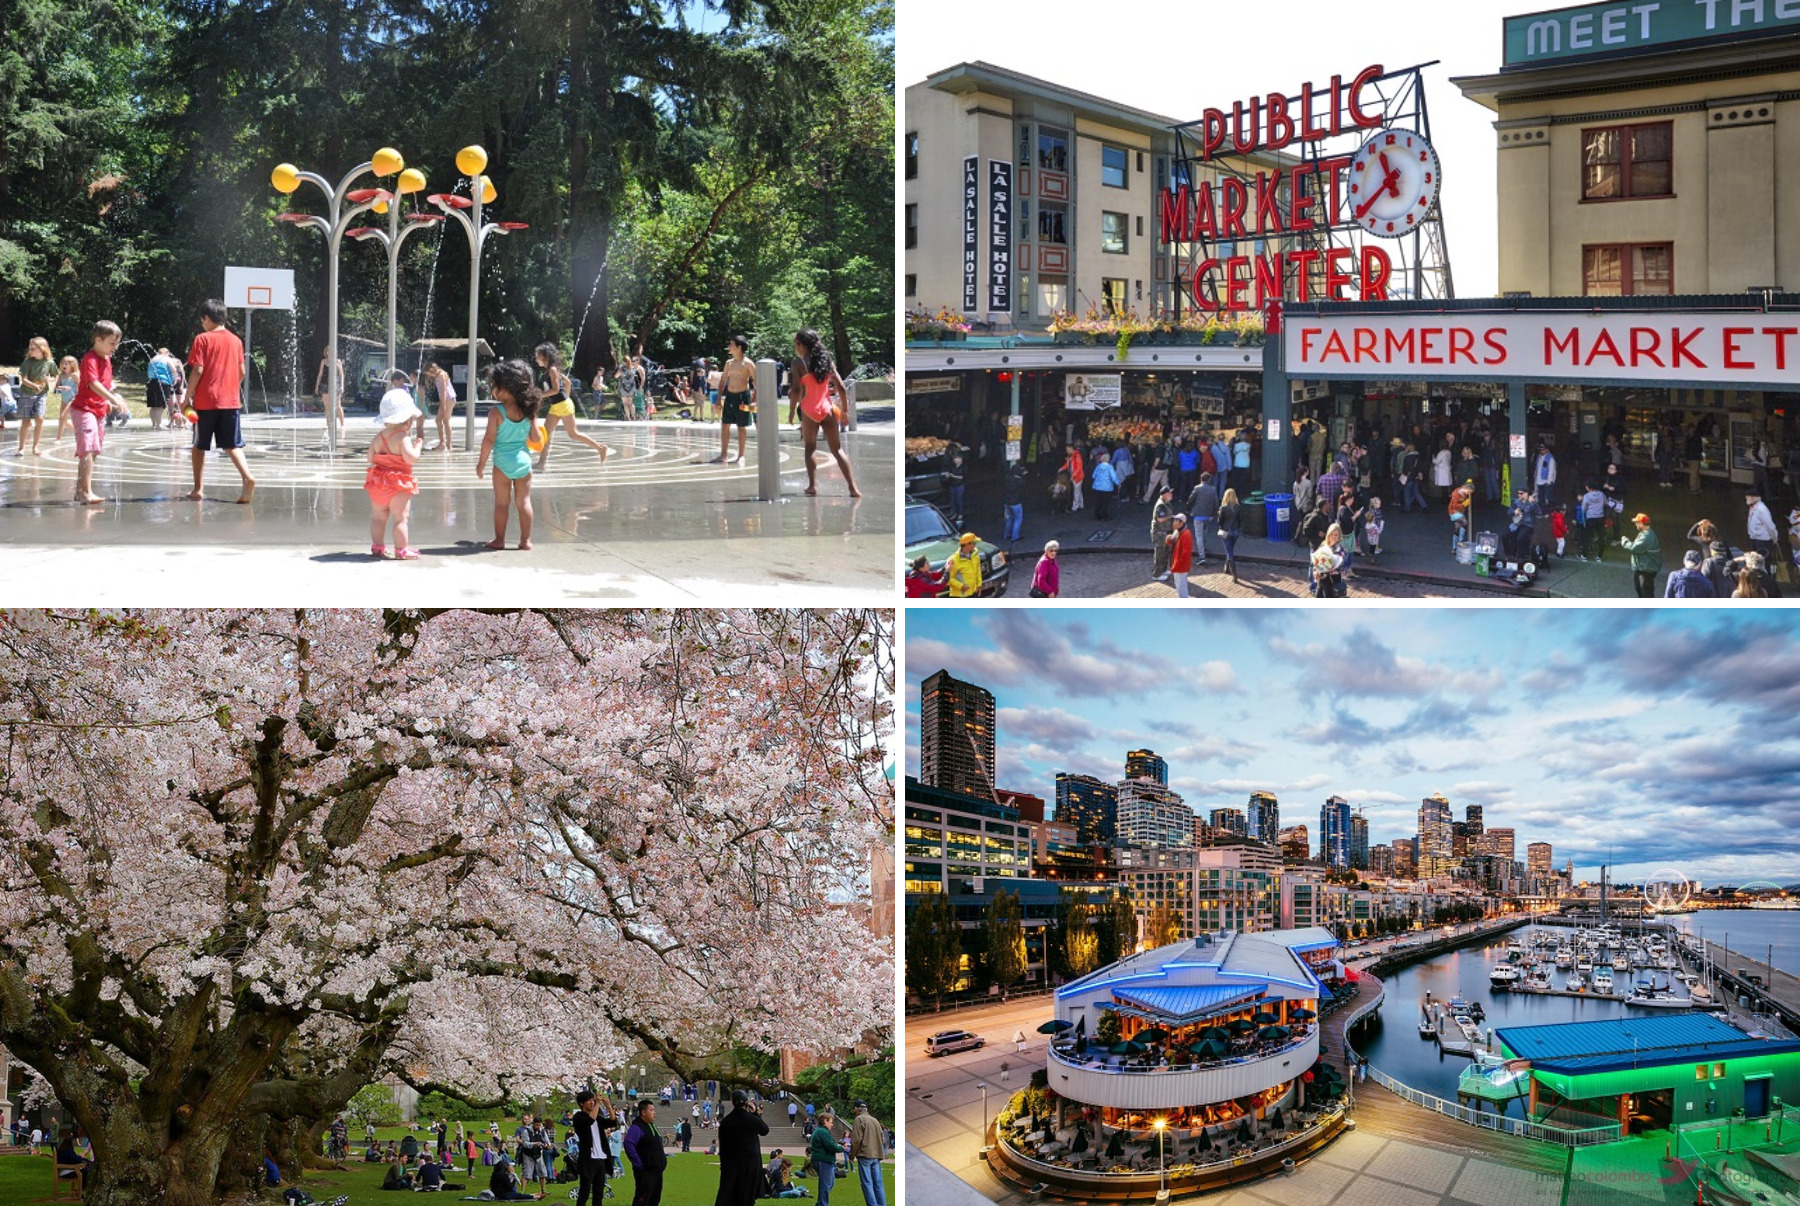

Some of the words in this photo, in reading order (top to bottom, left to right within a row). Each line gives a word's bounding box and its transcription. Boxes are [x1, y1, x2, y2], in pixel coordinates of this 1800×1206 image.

[1527, 3, 1660, 56] MEET
[1202, 64, 1384, 162] PUBLIC
[1386, 134, 1396, 145] 12
[1407, 137, 1412, 148] 1
[1368, 143, 1376, 155] 11
[1419, 151, 1427, 162] 2
[966, 162, 975, 183] LA
[993, 163, 1007, 186] LA
[1355, 161, 1365, 172] 10
[1425, 172, 1432, 184] 3
[1351, 184, 1358, 194] 9
[1161, 157, 1351, 244] MARKET
[1418, 196, 1427, 207] 4
[966, 187, 975, 244] SALLE
[993, 191, 1007, 246] SALLE
[1369, 218, 1376, 228] 7
[1406, 213, 1414, 225] 5
[1386, 222, 1394, 233] 6
[965, 251, 975, 307] HOTEL
[993, 252, 1007, 307] HOTEL
[1192, 246, 1392, 312] CENTER
[1301, 327, 1508, 365] FARMERS
[1543, 327, 1798, 370] MARKET
